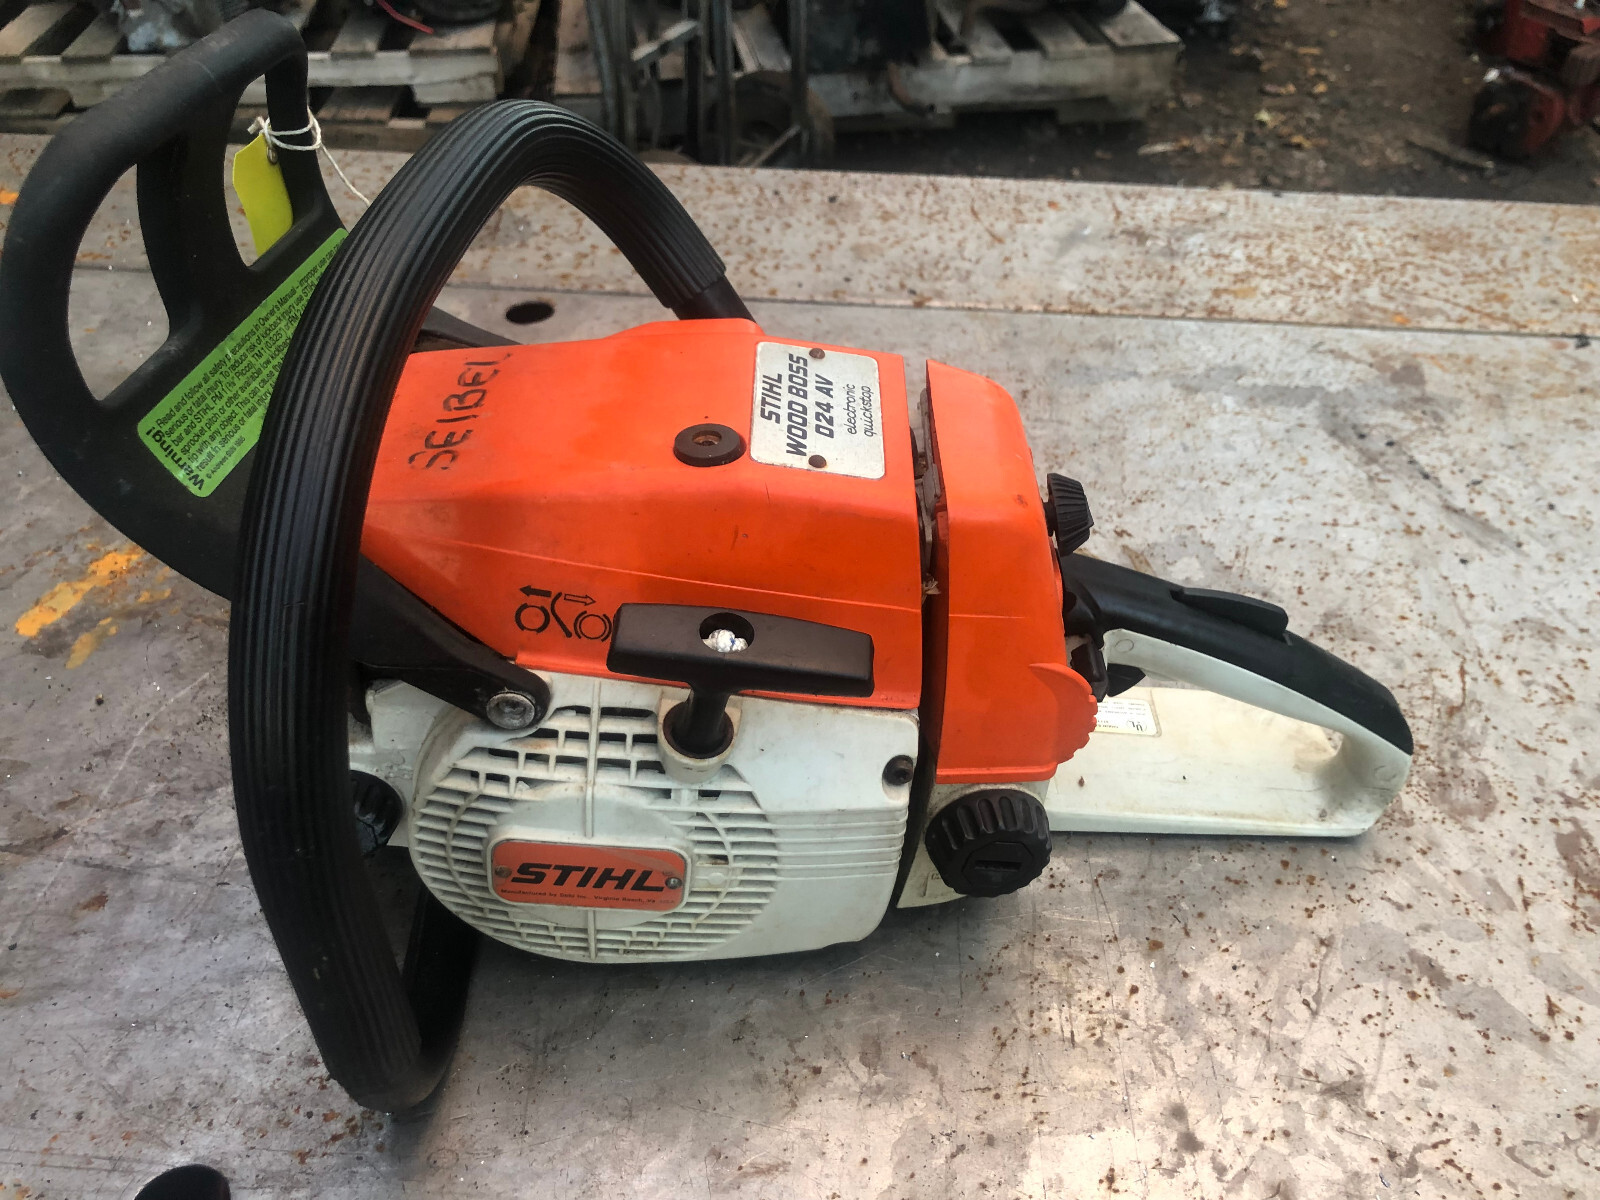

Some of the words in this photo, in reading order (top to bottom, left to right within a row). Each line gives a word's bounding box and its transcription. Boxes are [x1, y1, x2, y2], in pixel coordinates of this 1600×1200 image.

[280, 303, 299, 321] injury
[294, 294, 304, 306] use
[256, 334, 263, 345] of
[259, 316, 283, 339] kickback
[155, 408, 176, 428] Read
[174, 396, 188, 412] and
[184, 381, 204, 400] follow
[202, 372, 210, 384] all
[208, 358, 228, 378] safety
[252, 323, 261, 332] in
[276, 286, 297, 307] Manual
[228, 352, 248, 373] reduce
[246, 342, 257, 353] risk
[219, 370, 230, 380] To
[788, 353, 808, 400] BOSS
[815, 374, 833, 398] AV
[170, 432, 184, 446] bar
[183, 419, 197, 436] and
[193, 403, 215, 424] STIHL
[210, 390, 224, 405] PM
[251, 349, 264, 362] TM
[180, 426, 208, 456] sprocket
[204, 412, 222, 431] pitch
[218, 405, 226, 415] or
[224, 390, 241, 408] other
[238, 367, 263, 394] available
[259, 357, 272, 370] low
[186, 406, 194, 416] or
[192, 392, 208, 408] fatal
[760, 373, 782, 424] STIHL
[843, 384, 857, 435] electronic
[860, 386, 877, 437] quickstop
[164, 413, 188, 438] serious
[186, 452, 199, 464] tip
[195, 439, 211, 455] with
[208, 428, 222, 442] any
[234, 396, 251, 411] This
[248, 386, 260, 399] can
[258, 370, 275, 388] cause
[786, 400, 808, 456] WOOD
[196, 452, 216, 472] result
[210, 445, 221, 454] in
[218, 423, 241, 448] serious
[238, 416, 246, 426] or
[242, 402, 258, 419] fatal
[147, 428, 205, 491] Warning!
[511, 862, 666, 892] STIHL
